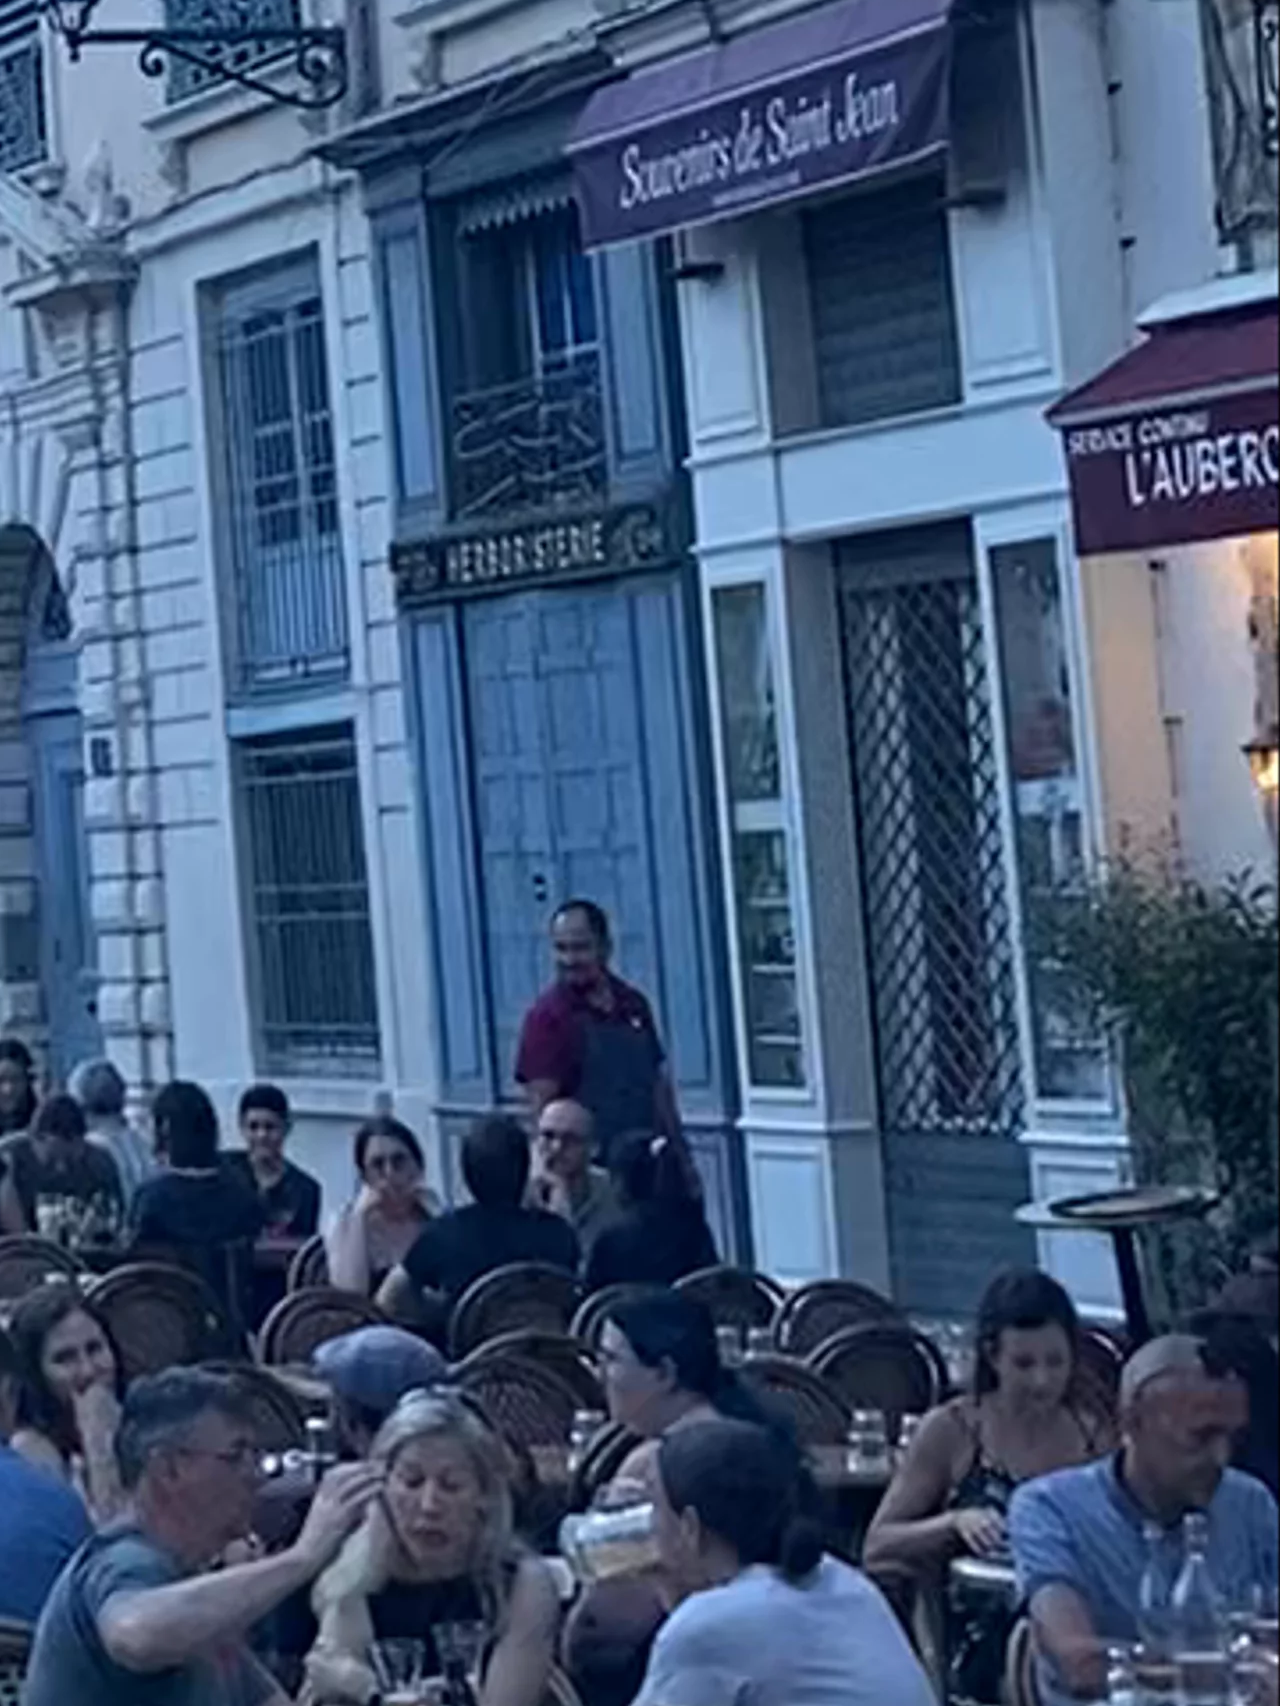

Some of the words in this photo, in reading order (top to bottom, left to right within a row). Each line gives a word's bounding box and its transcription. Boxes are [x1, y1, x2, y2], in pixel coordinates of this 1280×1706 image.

[619, 128, 731, 210] Souvenirs
[733, 109, 763, 173] de
[766, 90, 831, 165] Saint
[836, 72, 899, 142] Jean
[445, 519, 605, 583] HERBORISTERIE
